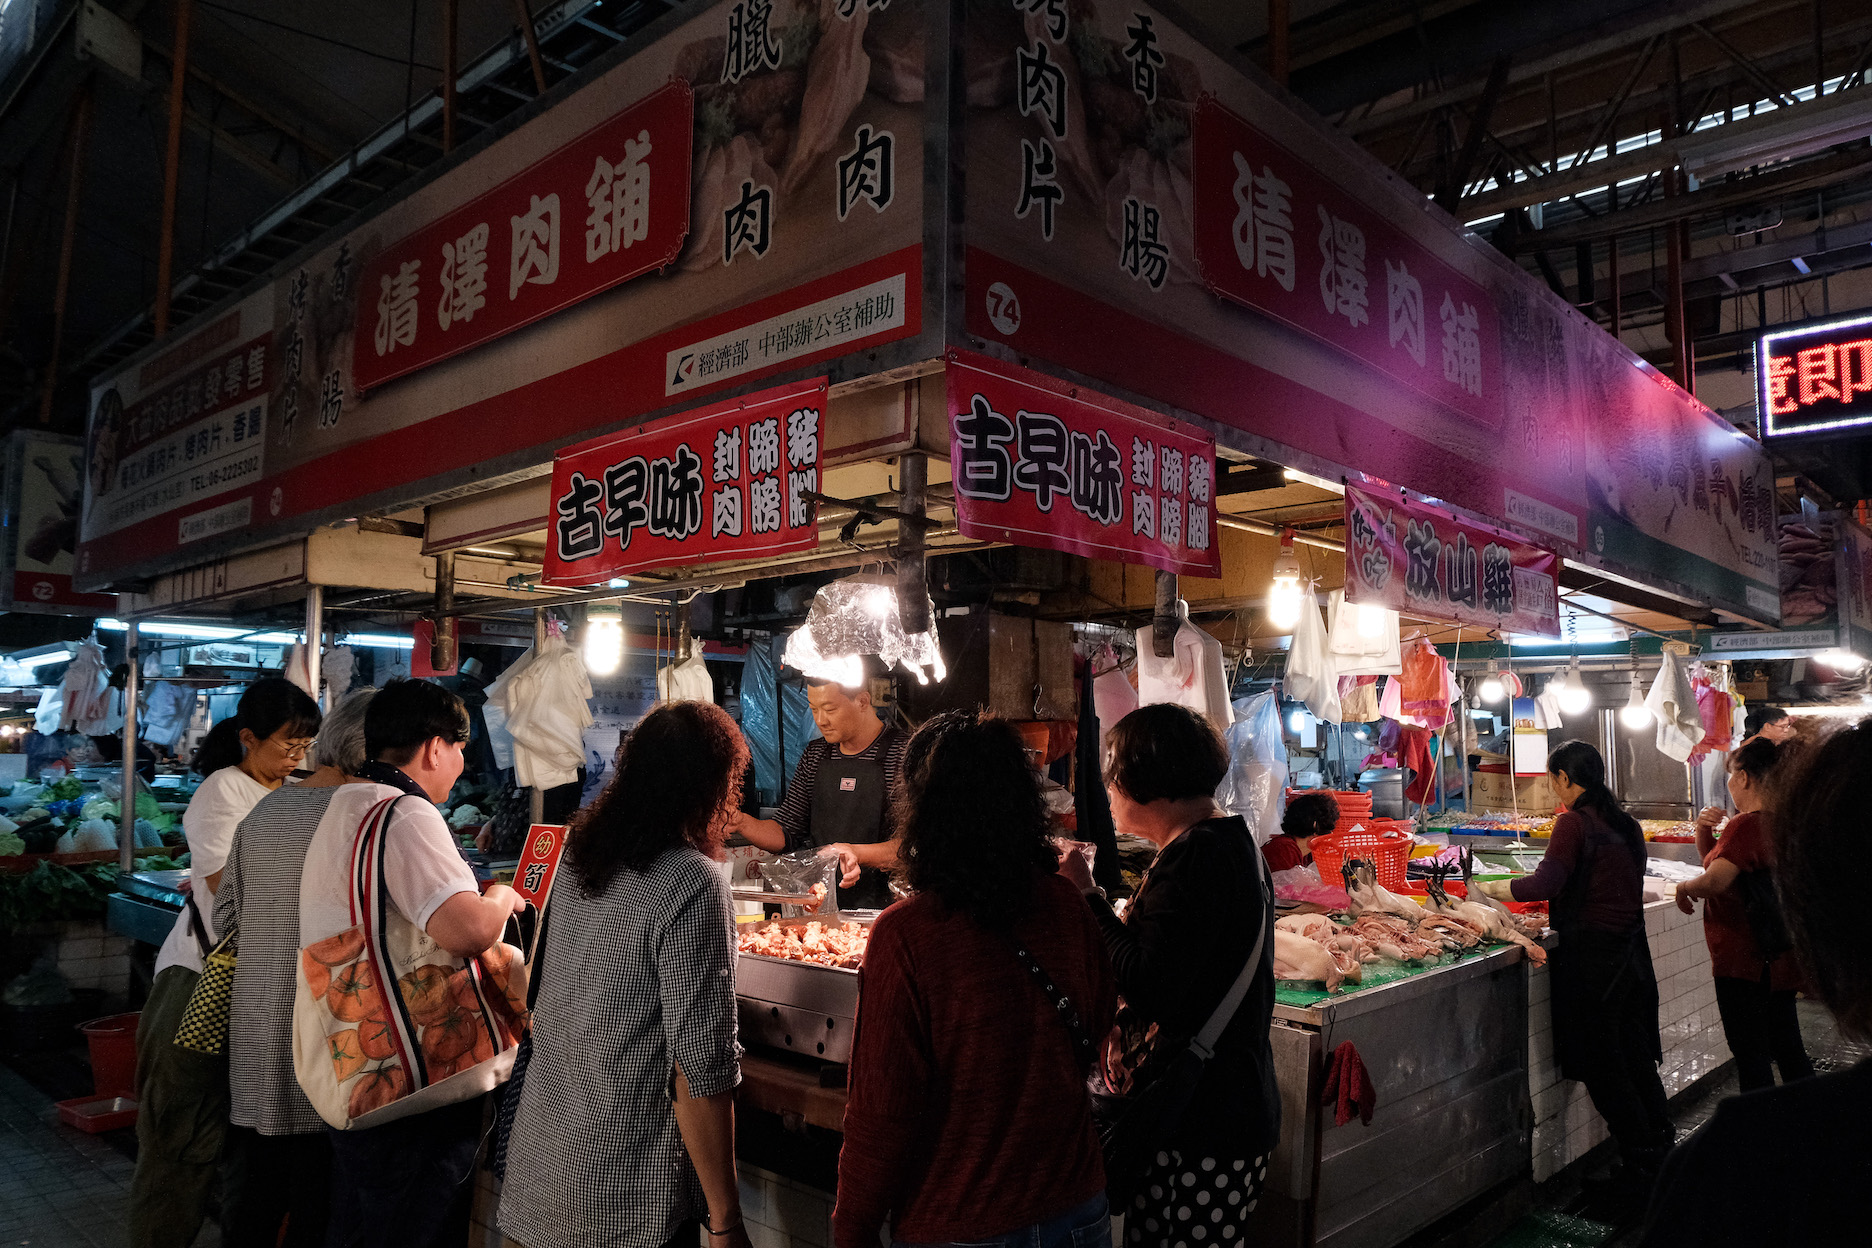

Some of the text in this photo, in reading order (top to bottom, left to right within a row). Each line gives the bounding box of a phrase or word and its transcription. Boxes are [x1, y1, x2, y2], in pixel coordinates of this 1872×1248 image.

[838, 0, 897, 217] 肉
[1125, 12, 1166, 288] 香腸
[698, 292, 895, 377] 經濟部 中部辦公室補助
[987, 290, 1020, 325] 74
[557, 443, 704, 561] 古早味
[712, 426, 742, 538] 封肉
[749, 417, 781, 534] 蹄膀
[953, 393, 1124, 527] 古早味
[1131, 436, 1156, 539] 封肉
[1159, 446, 1183, 546] 蹄膀
[1187, 454, 1210, 551] 豬腳
[34, 585, 53, 596] 72
[1403, 518, 1514, 619] 放山雞
